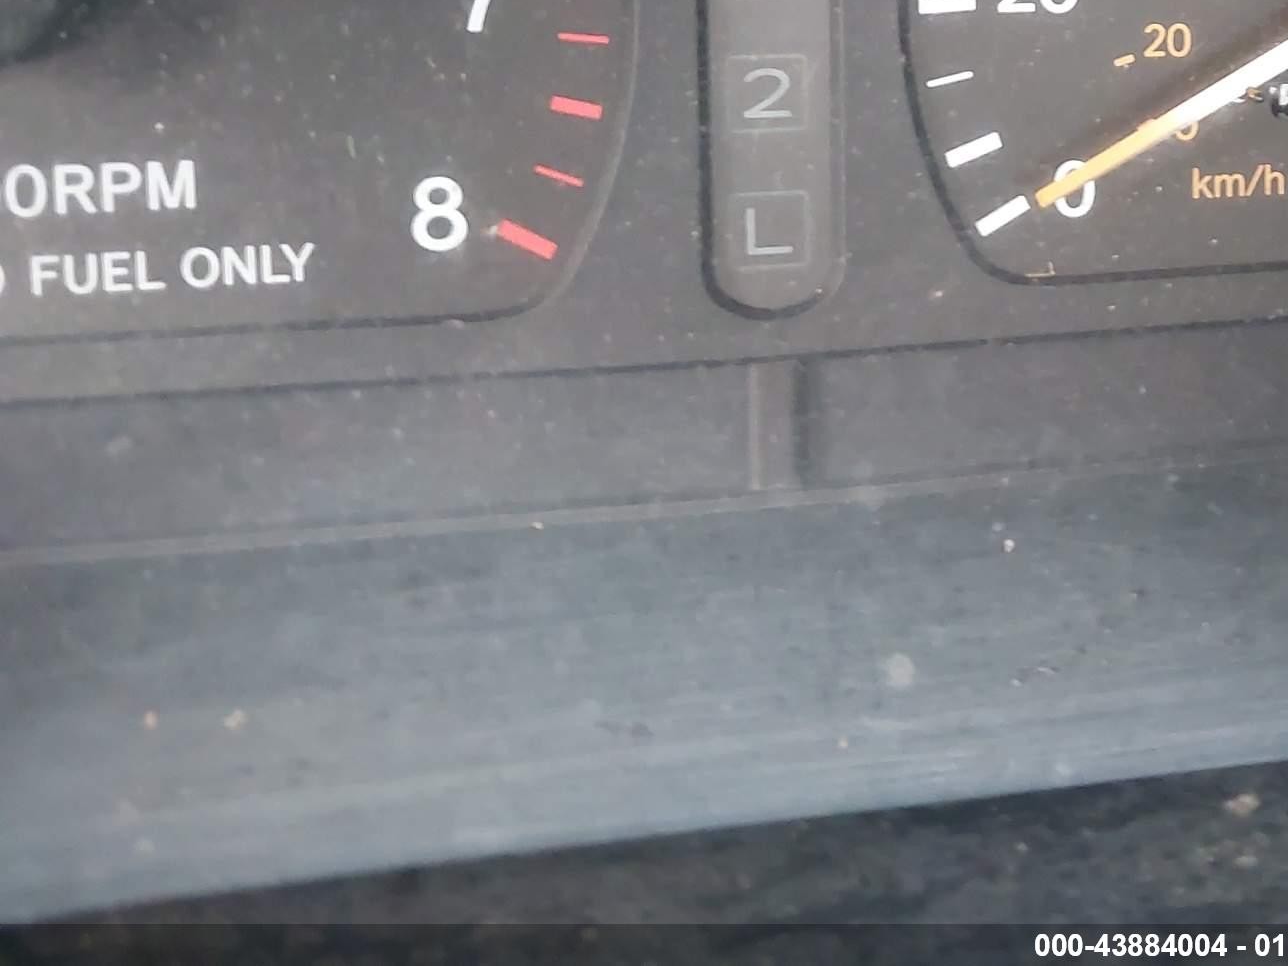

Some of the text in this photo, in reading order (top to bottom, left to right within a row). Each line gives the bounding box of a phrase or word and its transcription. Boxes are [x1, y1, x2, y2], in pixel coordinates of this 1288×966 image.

[1144, 23, 1191, 57] 20
[744, 68, 792, 118] 2
[1192, 164, 1284, 199] km/h
[412, 177, 467, 251] 8
[745, 208, 793, 255] L
[30, 251, 166, 296] FUEL
[181, 243, 314, 288] ONLY
